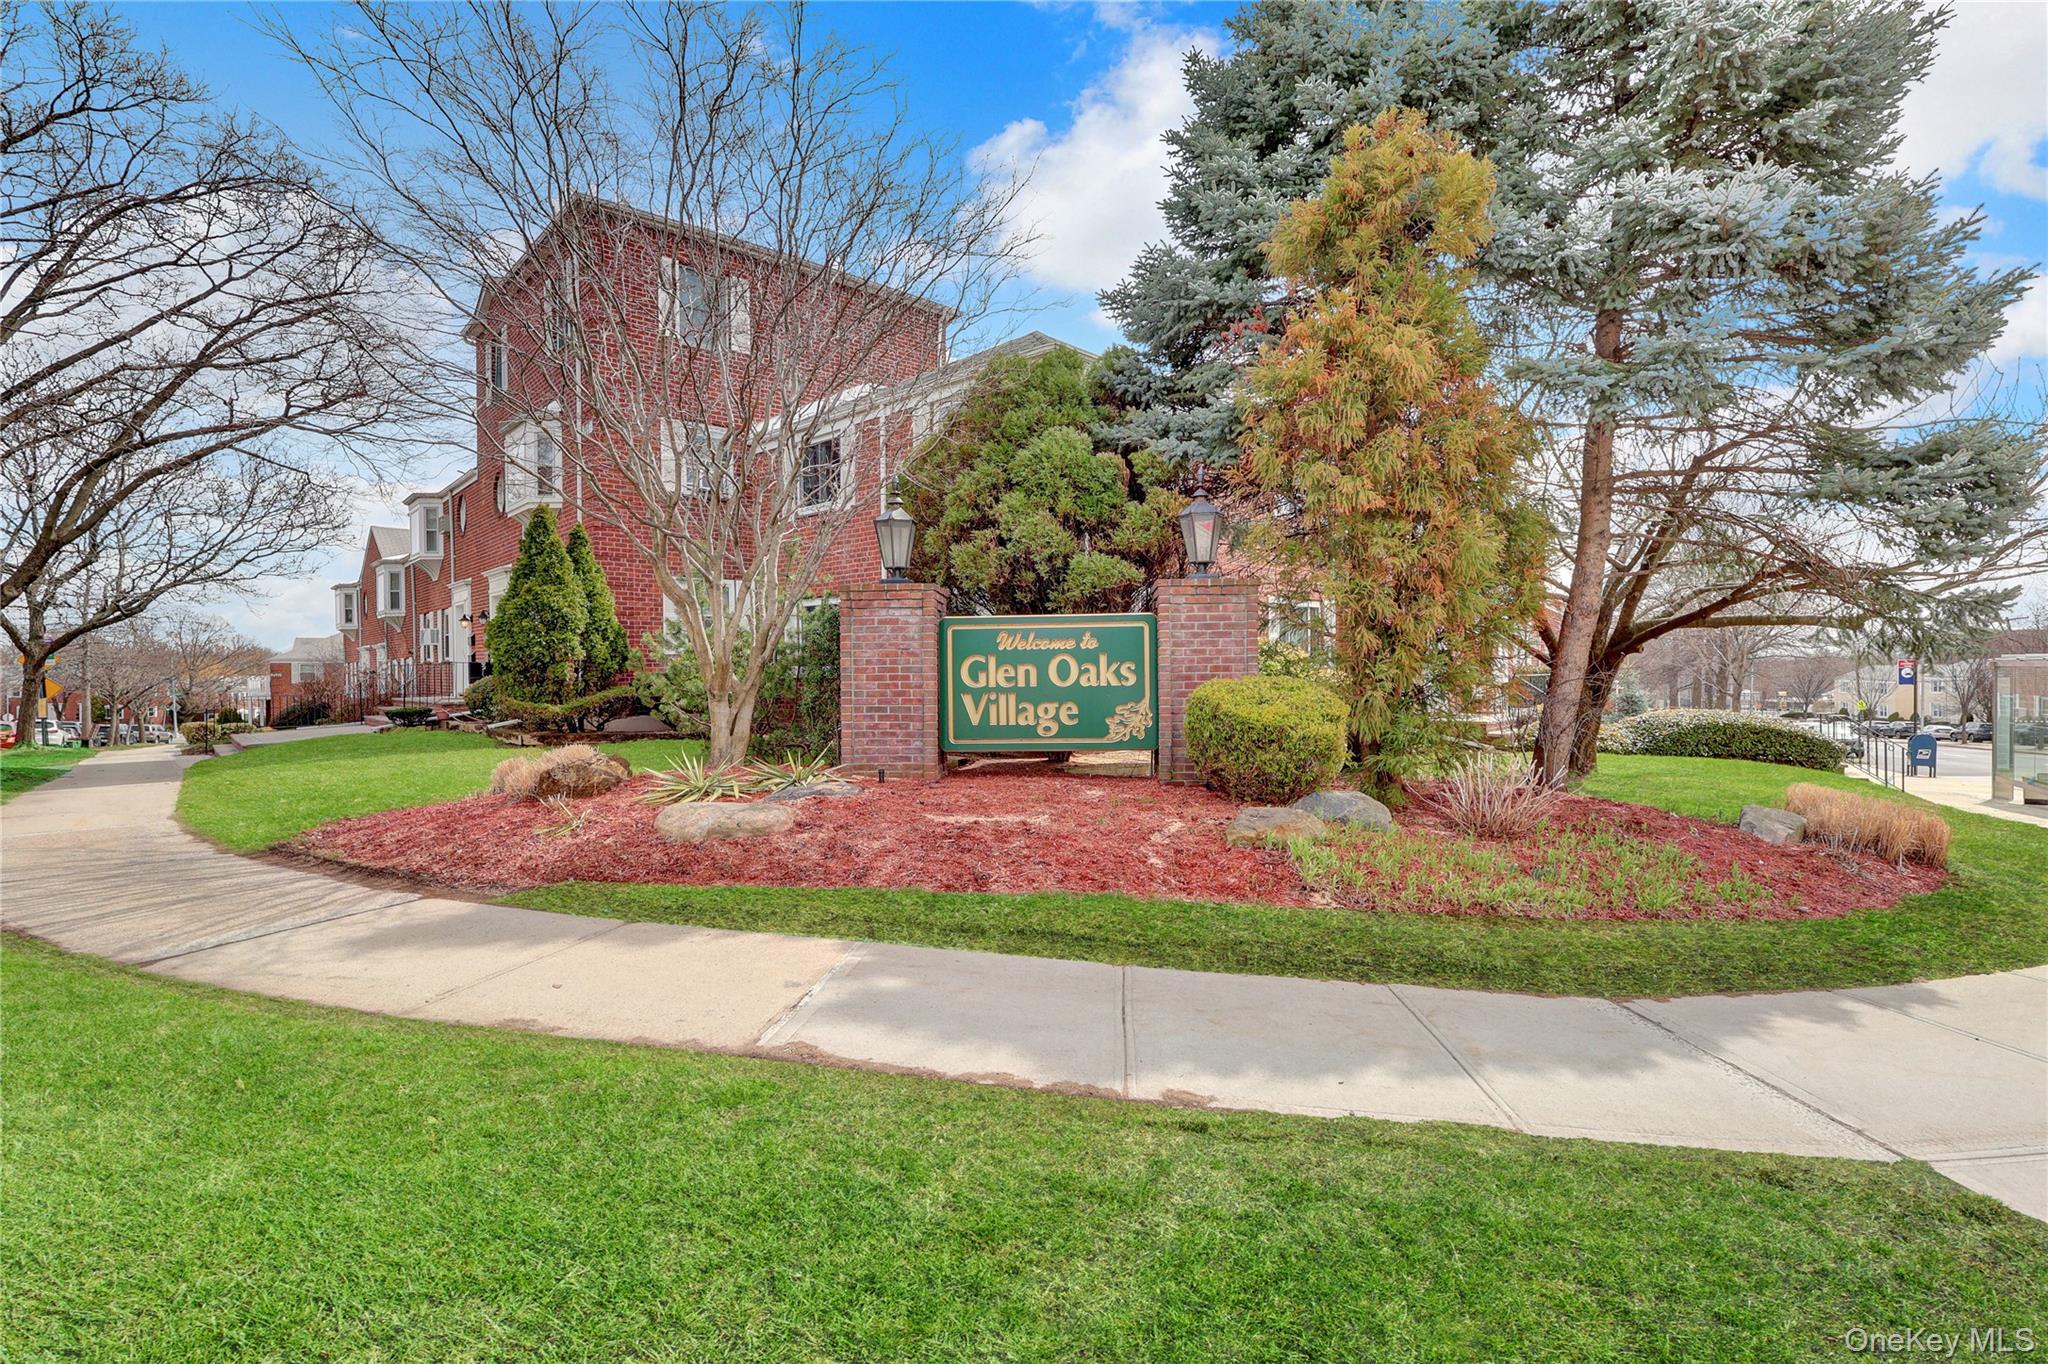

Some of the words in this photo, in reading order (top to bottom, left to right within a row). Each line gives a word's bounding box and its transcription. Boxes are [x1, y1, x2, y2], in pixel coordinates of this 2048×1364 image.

[997, 631, 1076, 651] Welcome
[1080, 631, 1099, 650] to
[960, 653, 1038, 688] Glen
[1048, 652, 1137, 687] Oaks
[961, 692, 1079, 737] Village
